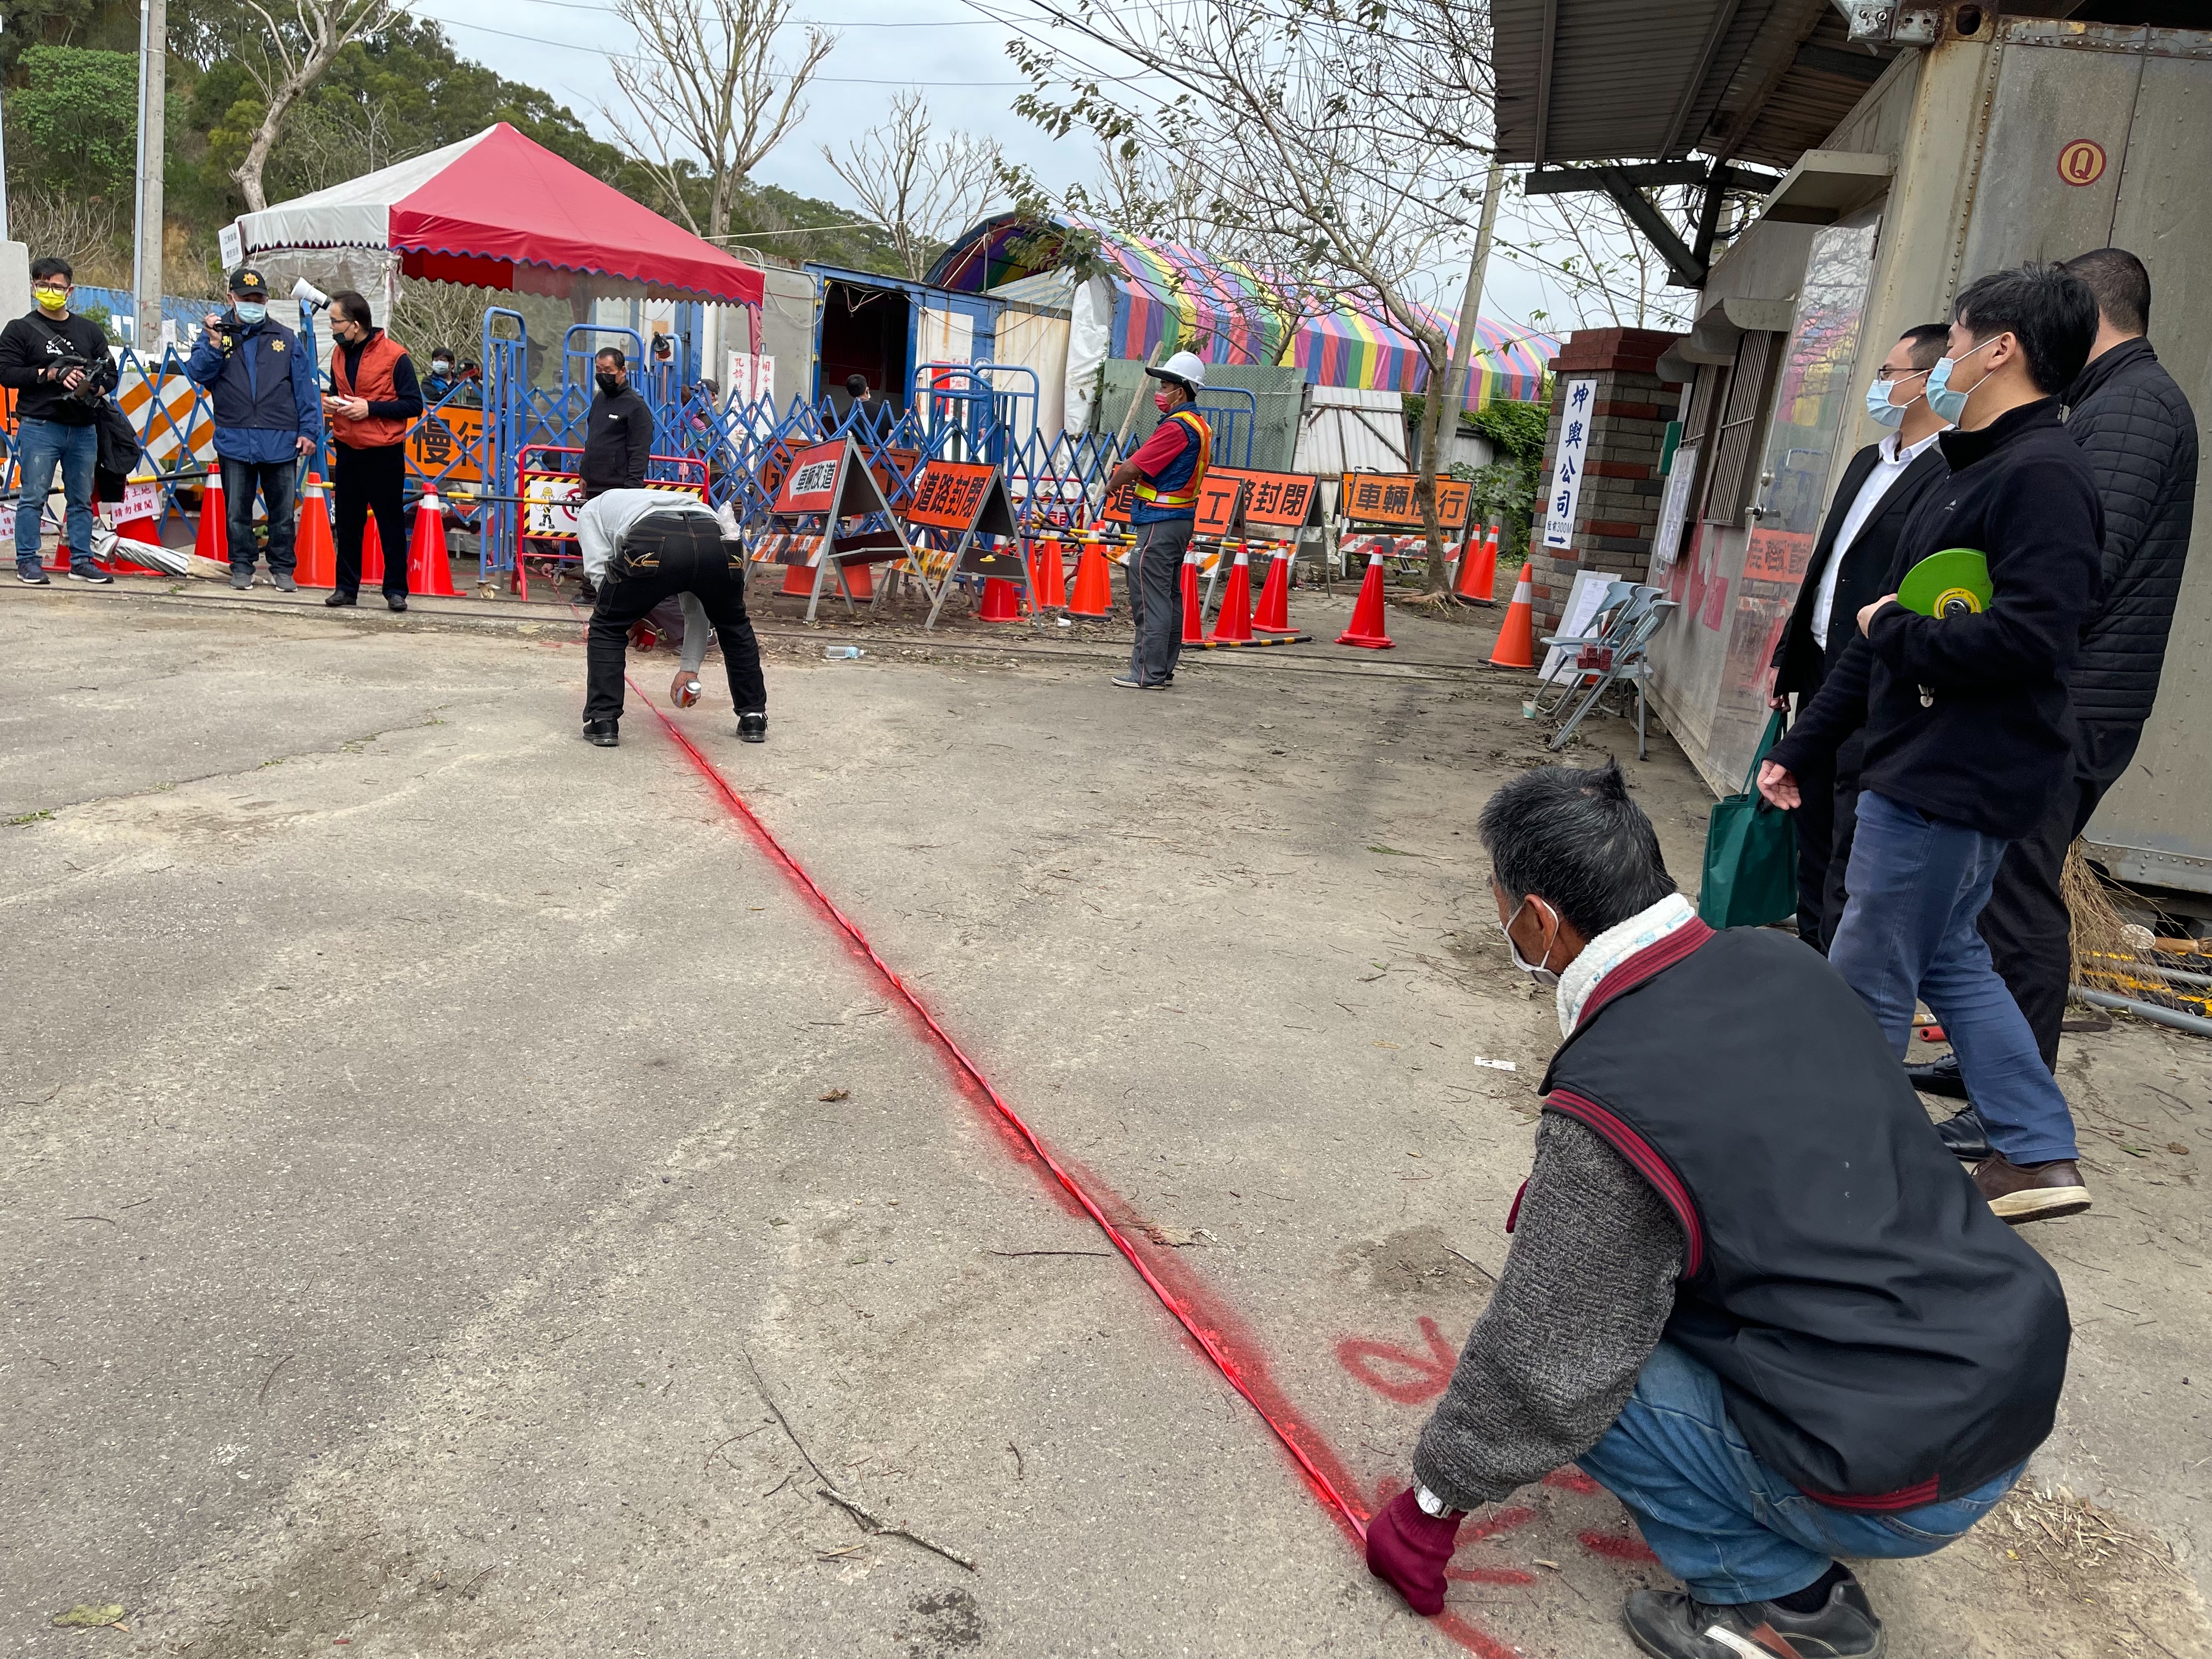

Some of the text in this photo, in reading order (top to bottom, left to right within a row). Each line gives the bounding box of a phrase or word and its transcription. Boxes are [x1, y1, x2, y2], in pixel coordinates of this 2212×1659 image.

[2069, 147, 2094, 179] Q
[795, 462, 836, 492] 車輛改道
[915, 471, 986, 518] 道路封閉
